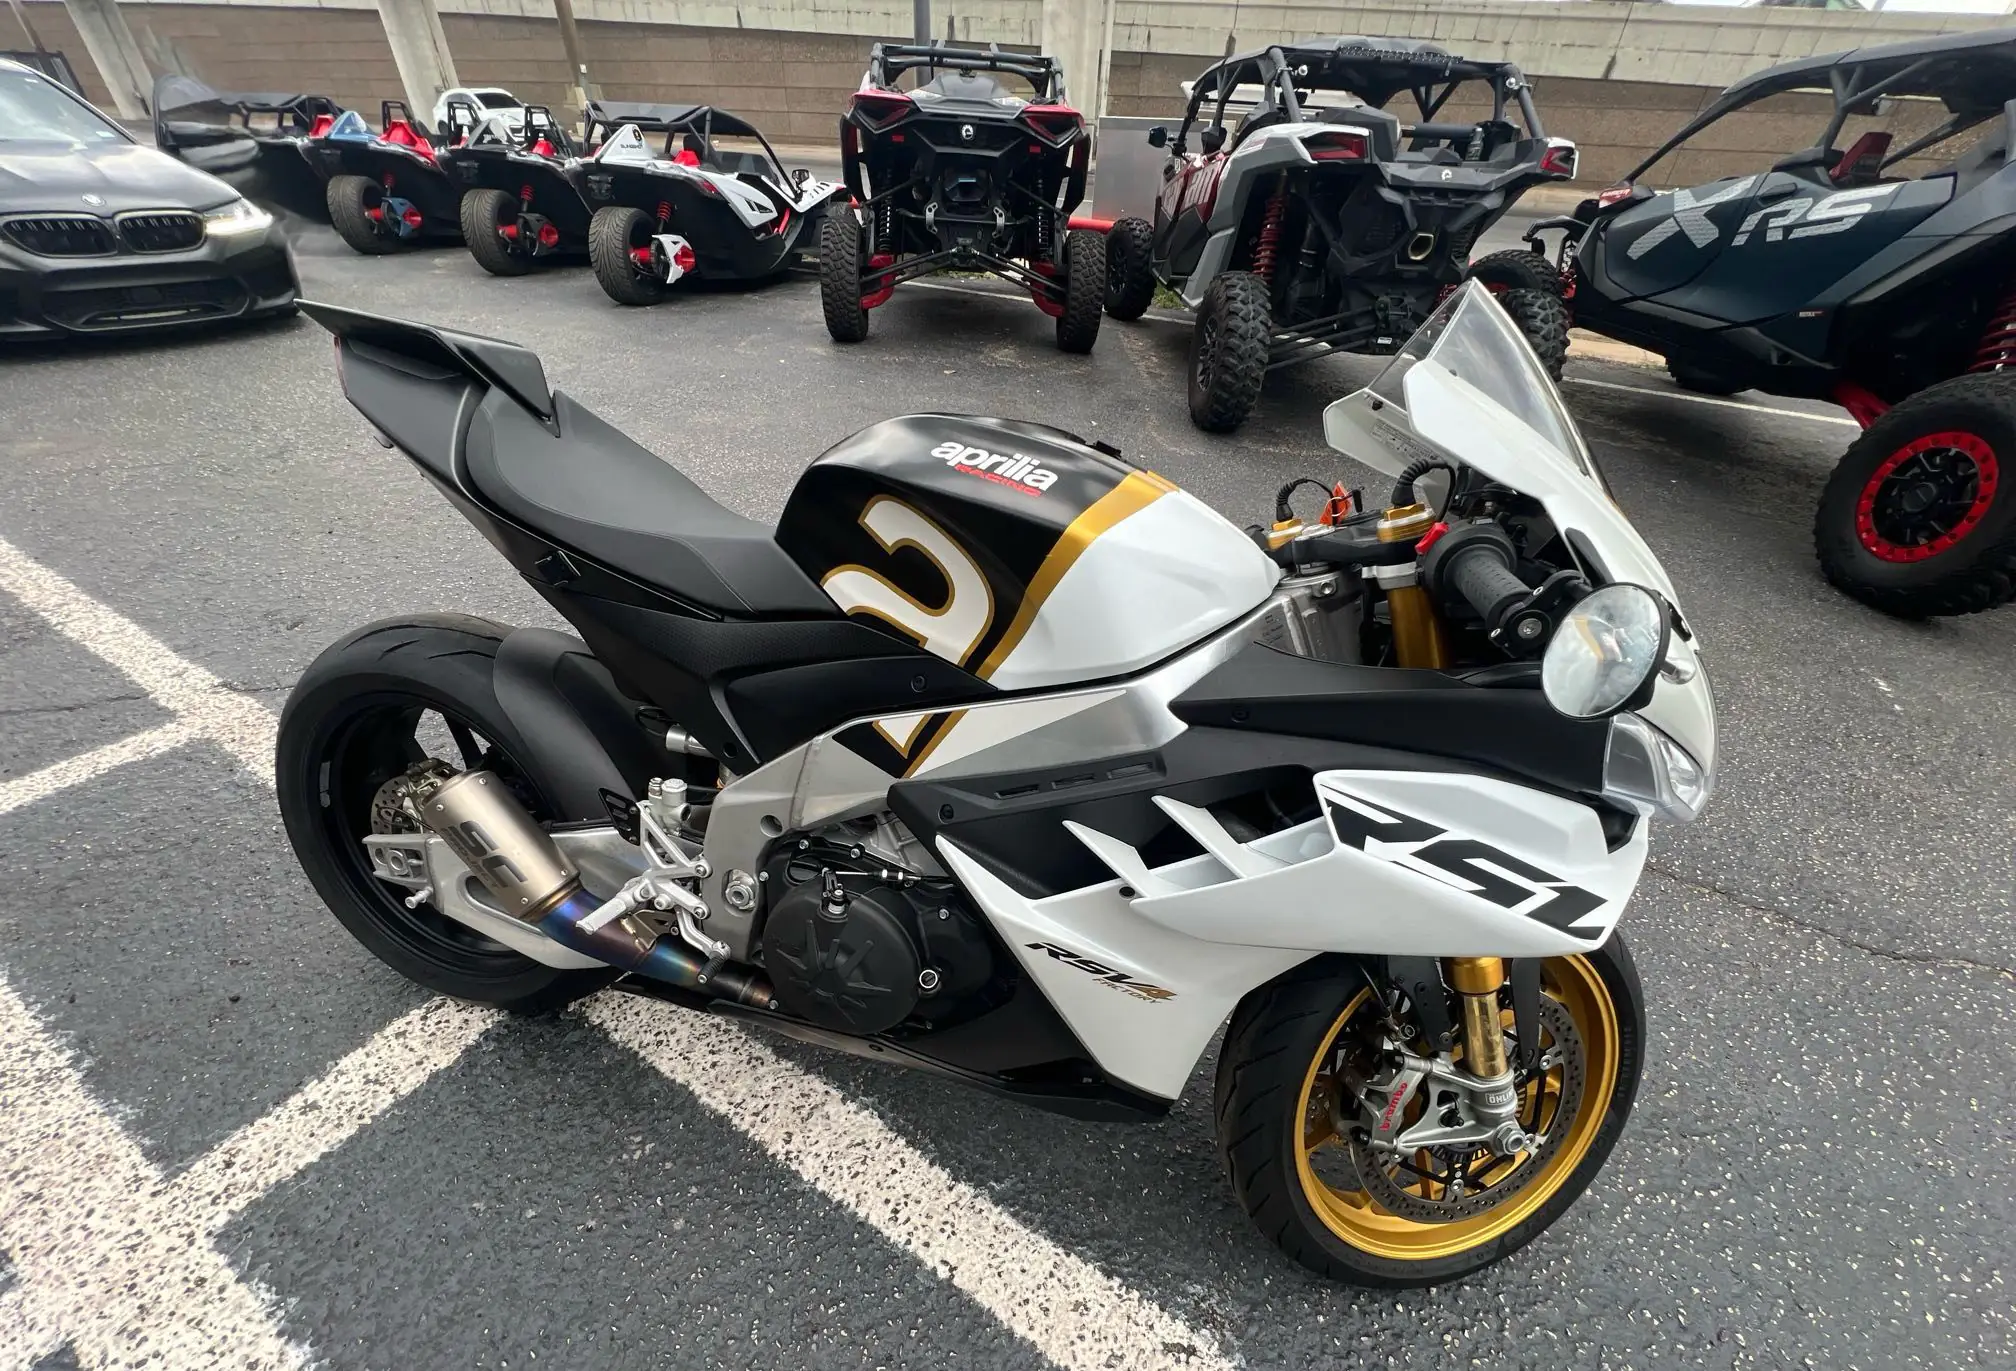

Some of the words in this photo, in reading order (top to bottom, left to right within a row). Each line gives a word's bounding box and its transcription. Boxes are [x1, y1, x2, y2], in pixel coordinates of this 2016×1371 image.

[1627, 175, 1757, 260] X
[930, 441, 1059, 492] aprilia
[954, 464, 1041, 497] RACING
[447, 820, 529, 888] SC
[1024, 942, 1178, 1001] RSV4
[1092, 978, 1162, 1004] FACTORY
[1379, 1080, 1408, 1132] brembo
[1488, 1090, 1515, 1104] ÖHLIN
